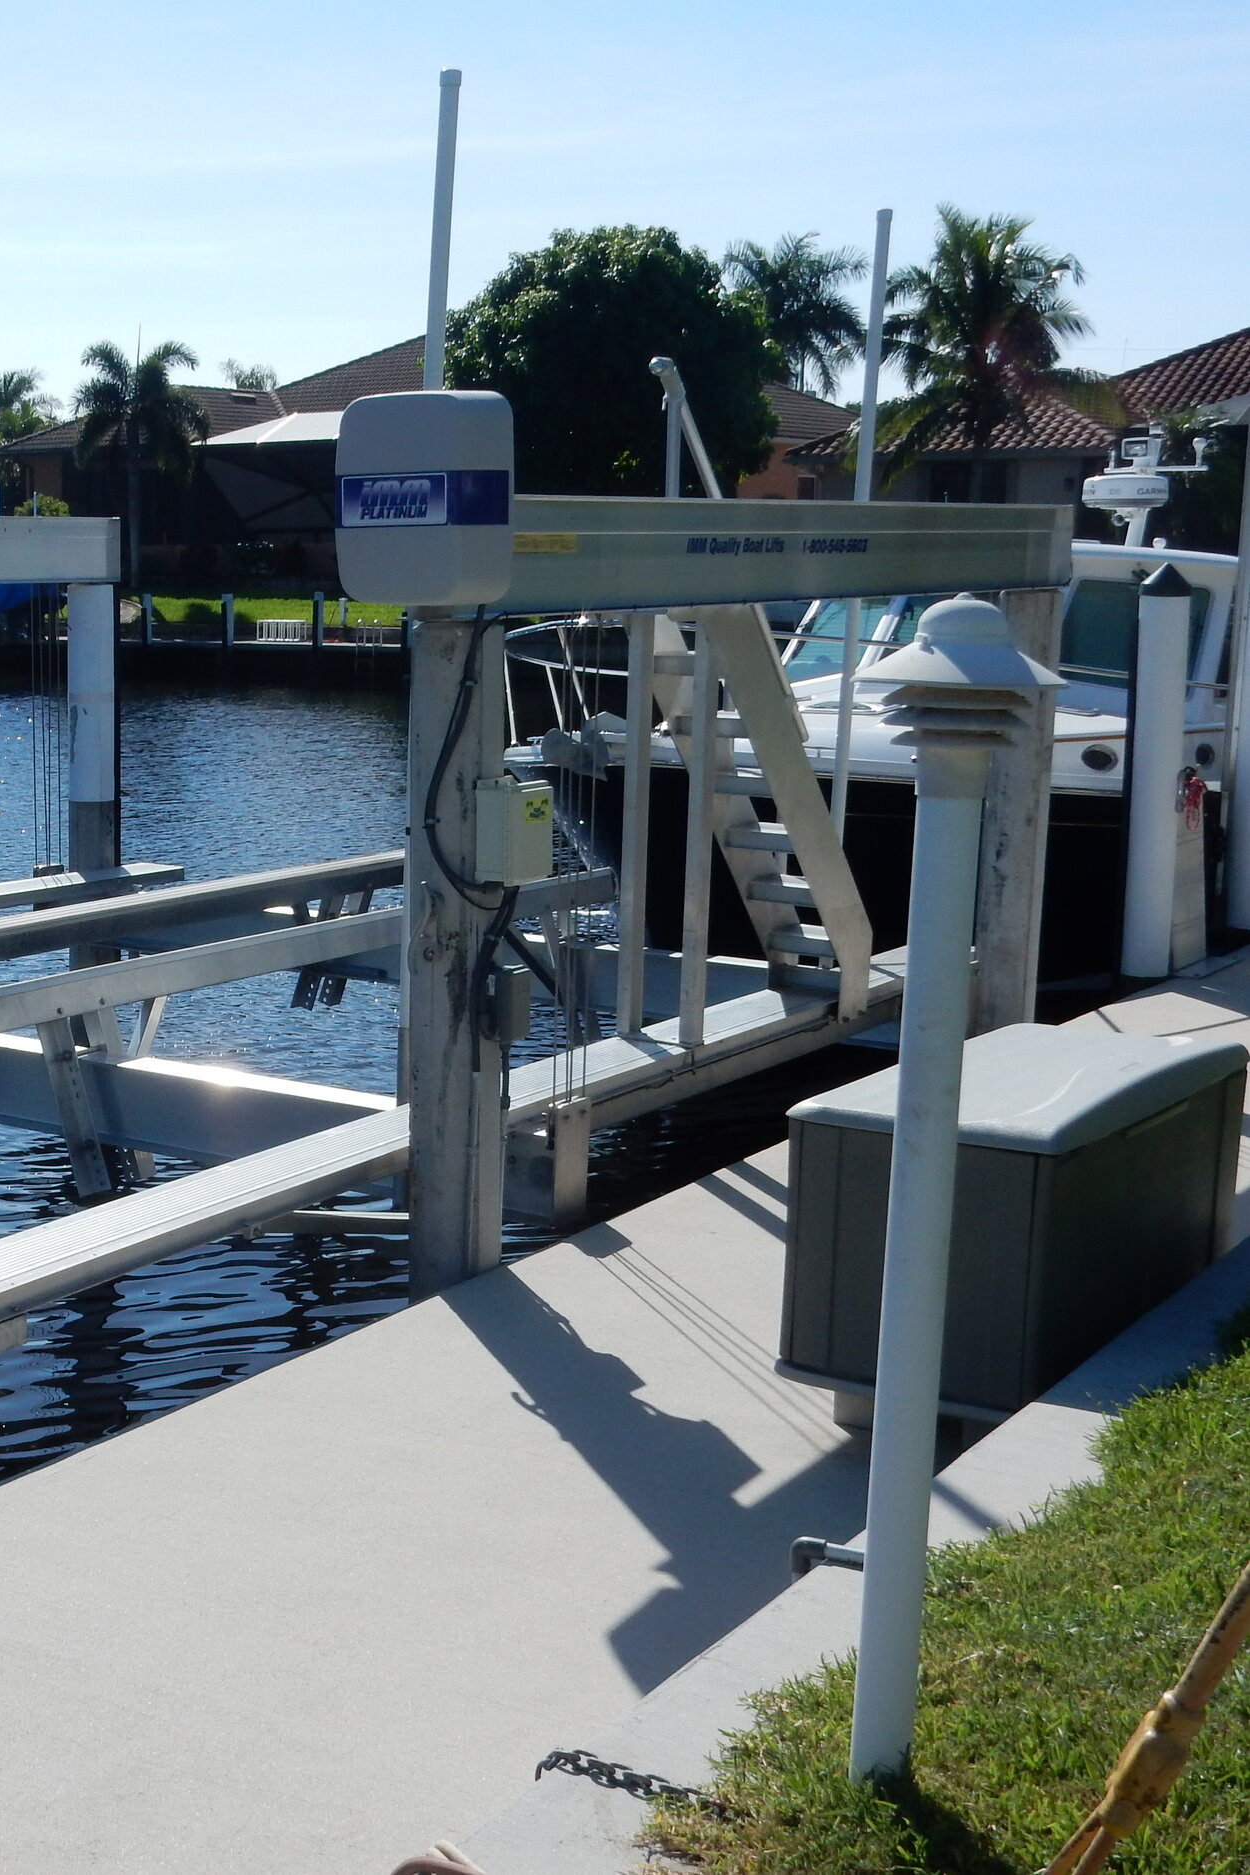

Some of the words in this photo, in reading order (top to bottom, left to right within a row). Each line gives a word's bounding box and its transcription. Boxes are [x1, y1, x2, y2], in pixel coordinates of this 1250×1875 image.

[359, 506, 429, 520] PLATINUM
[709, 538, 742, 556] Quality
[742, 538, 764, 554] Boat
[765, 537, 786, 553] Lifts
